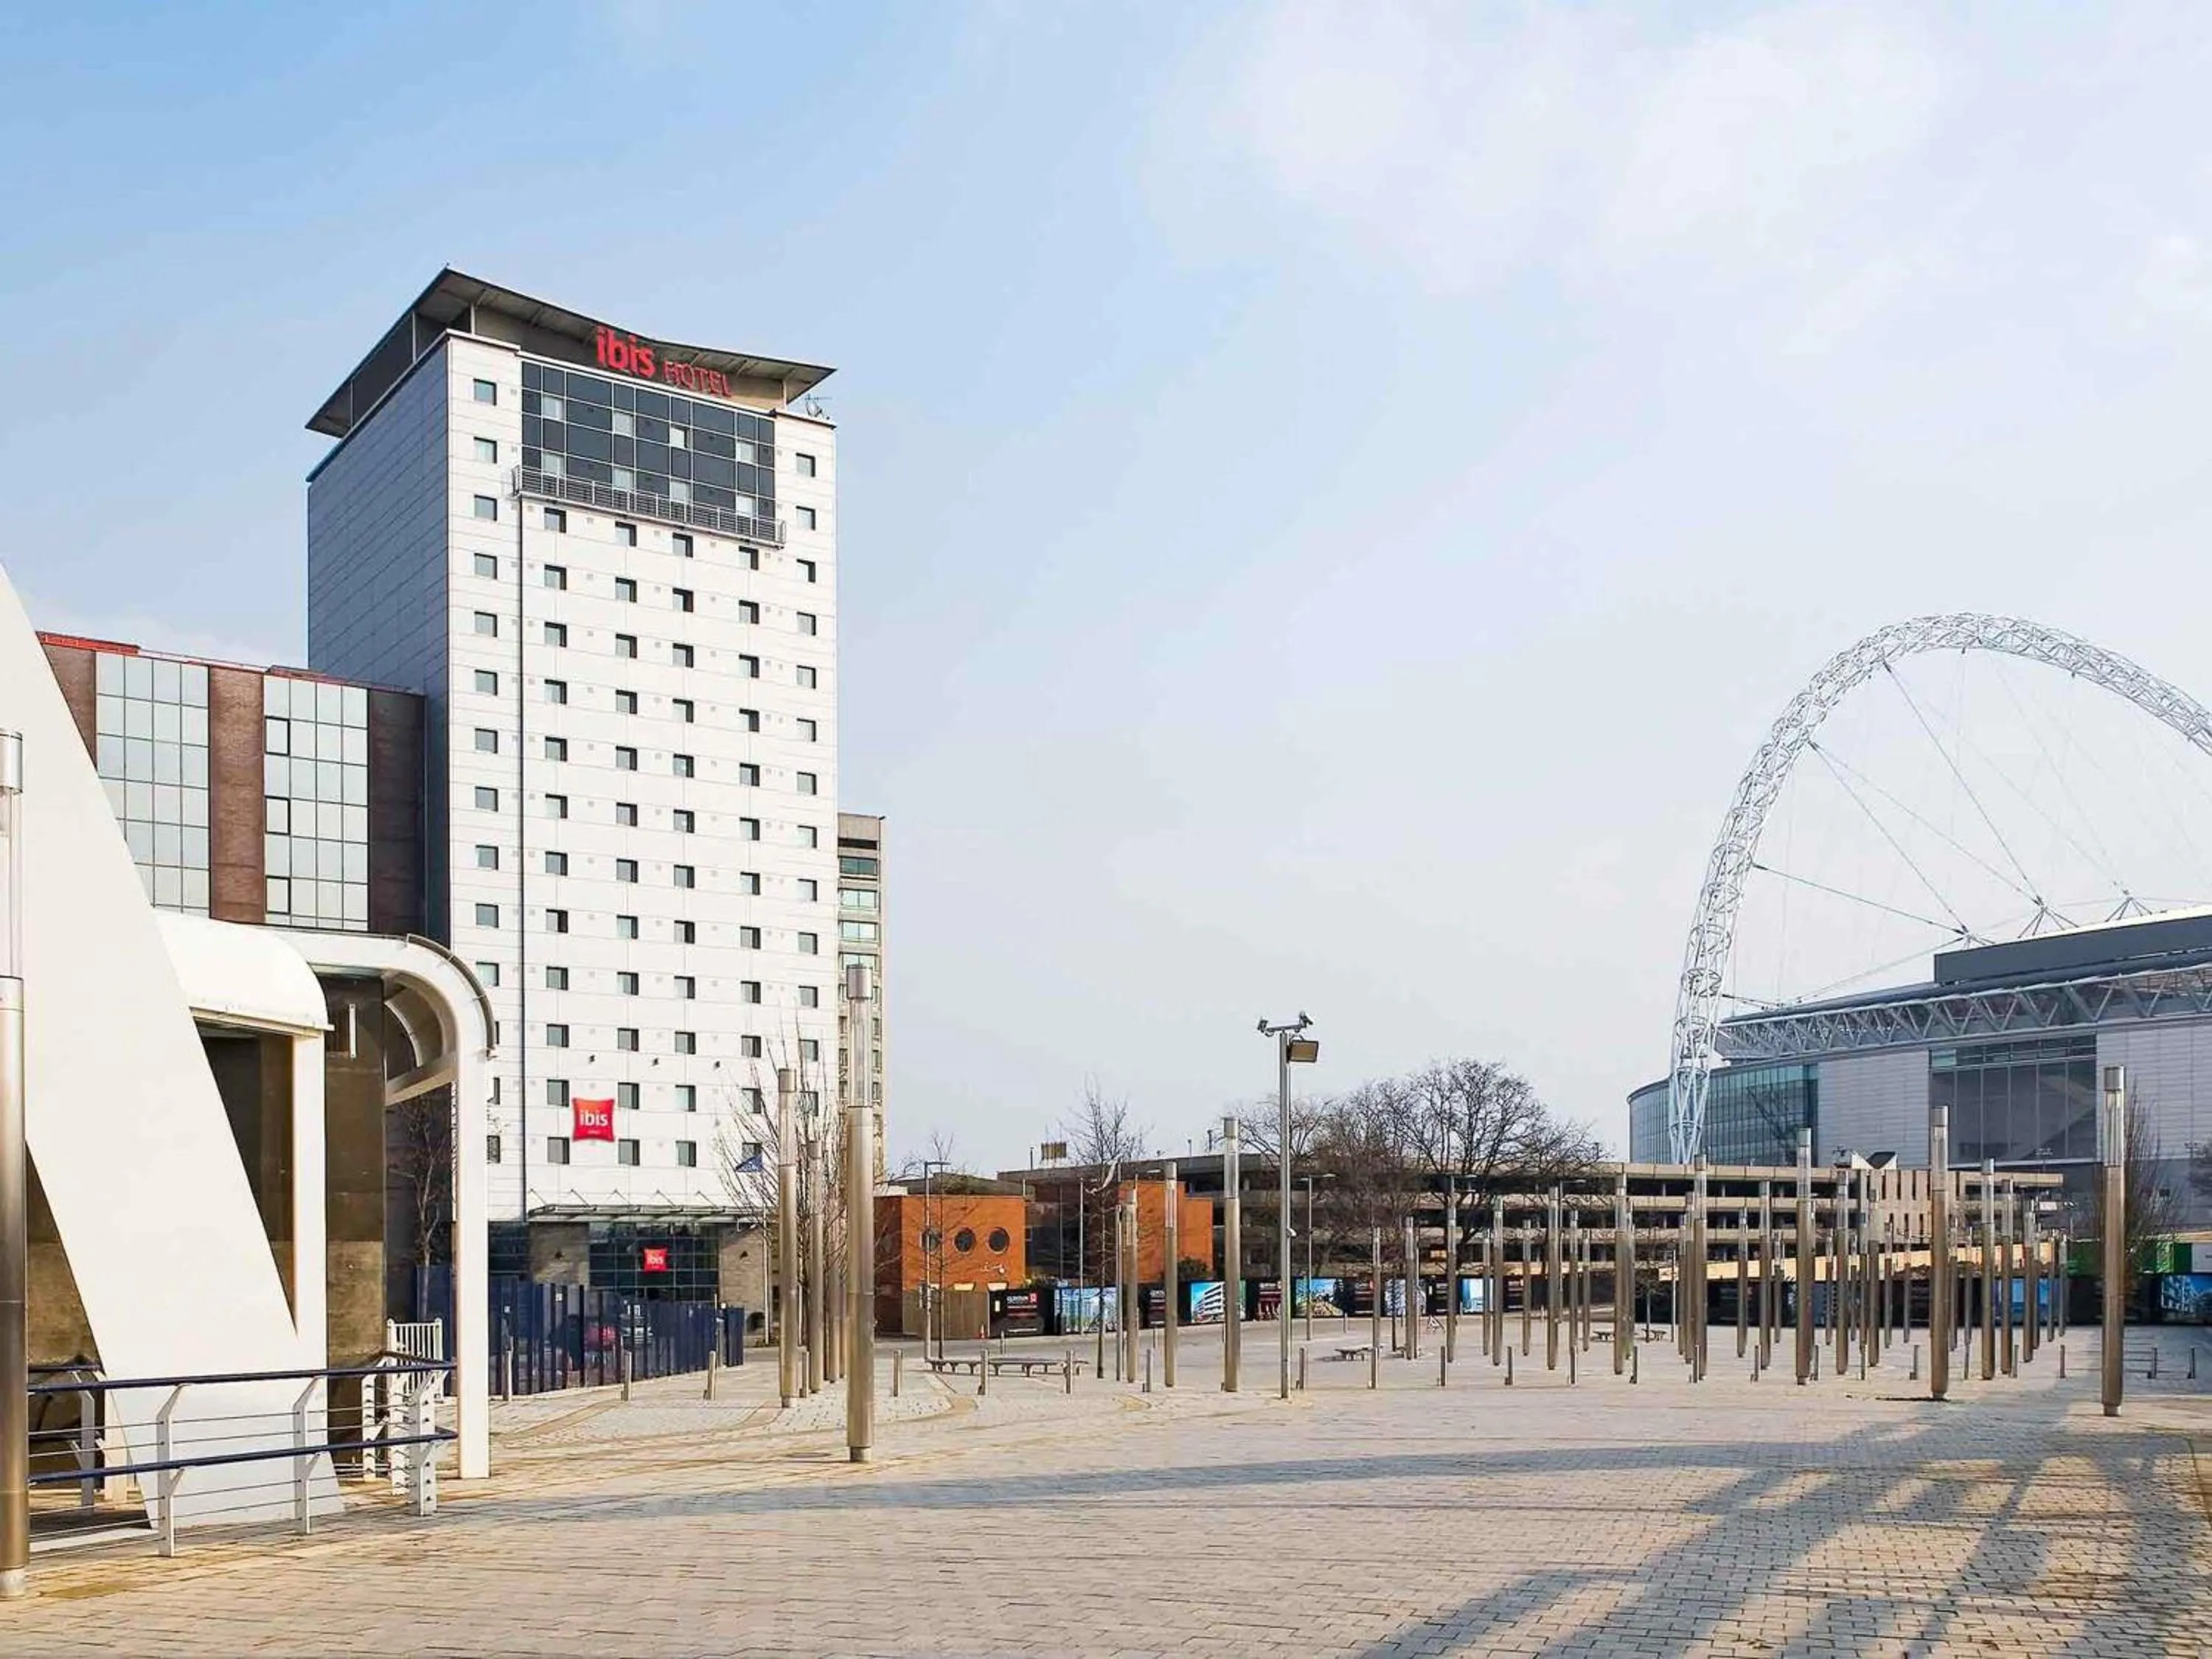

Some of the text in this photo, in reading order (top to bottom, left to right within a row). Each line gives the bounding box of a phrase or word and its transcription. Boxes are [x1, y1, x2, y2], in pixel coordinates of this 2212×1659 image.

[597, 325, 733, 397] ibis HOTEL
[580, 1108, 608, 1127] ibis
